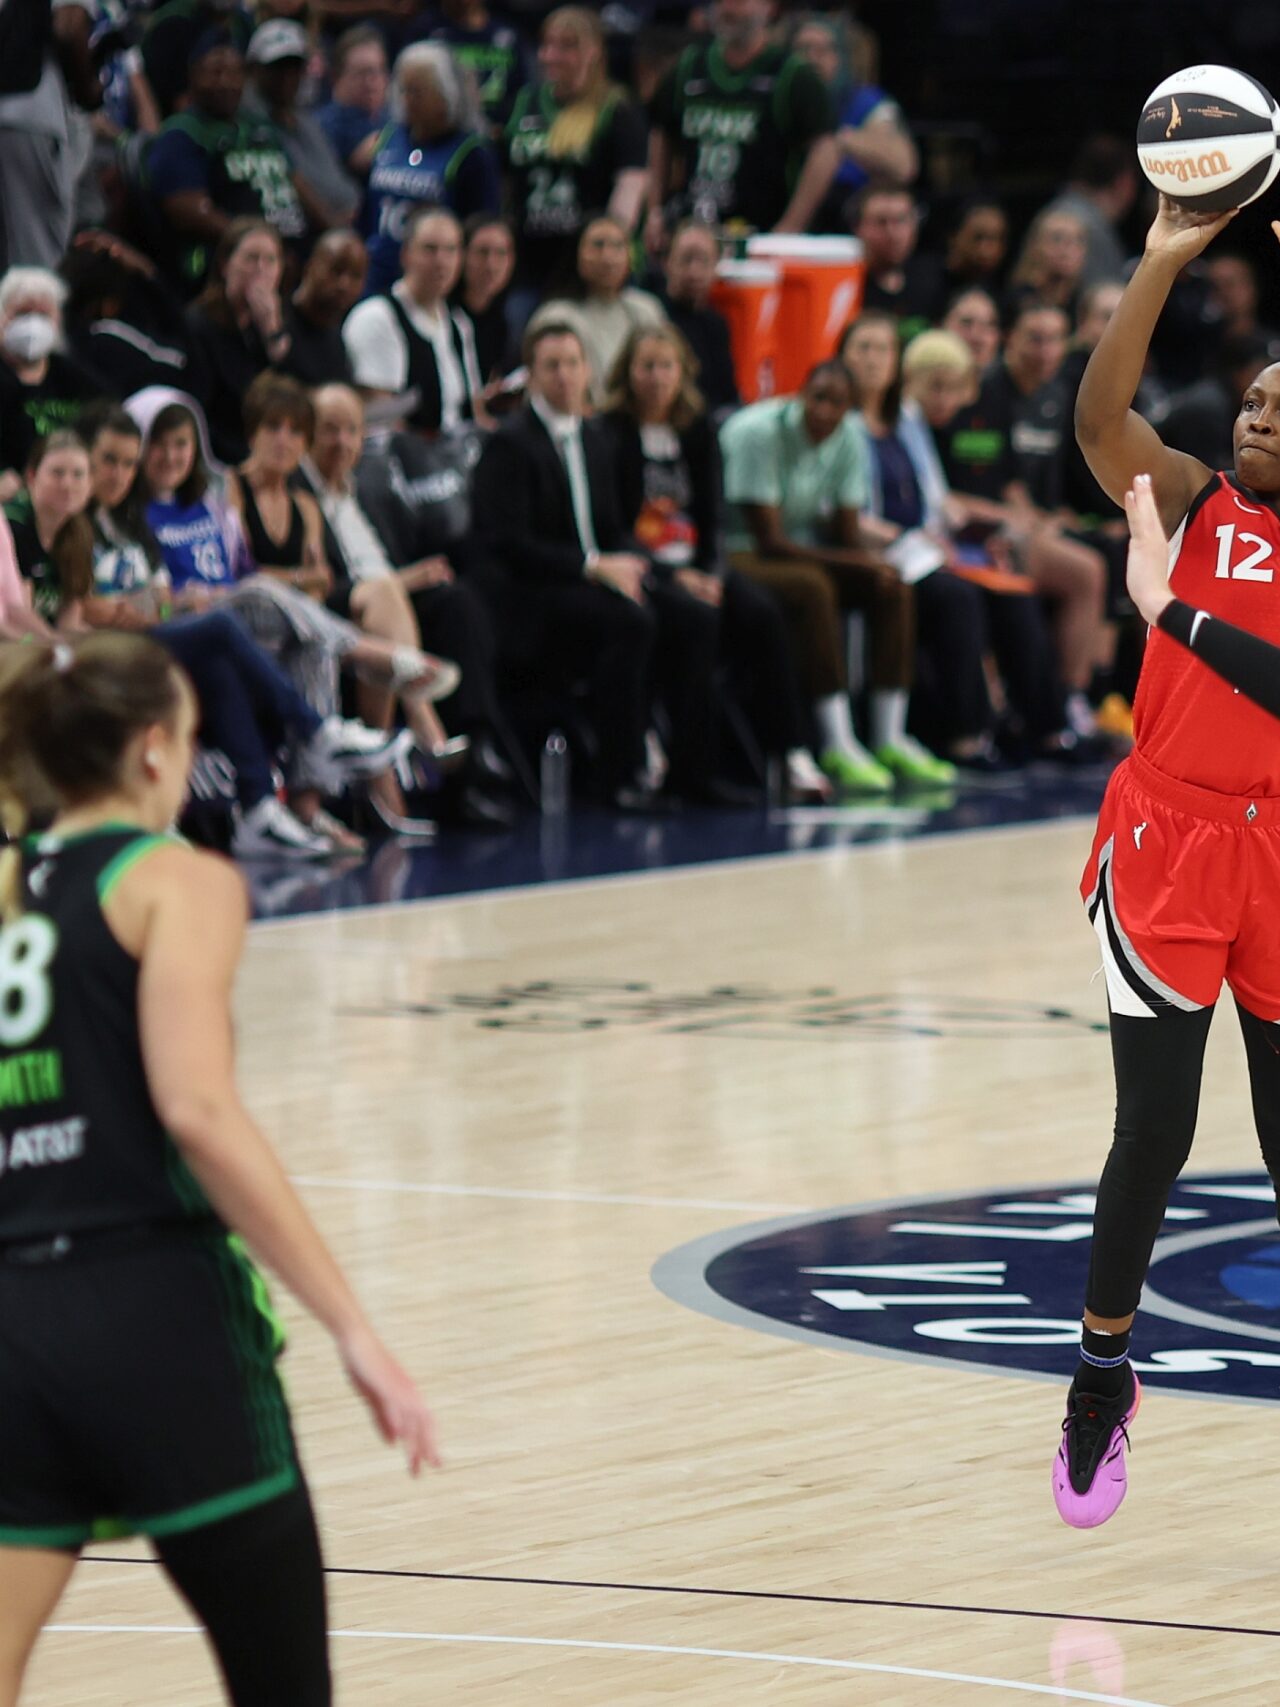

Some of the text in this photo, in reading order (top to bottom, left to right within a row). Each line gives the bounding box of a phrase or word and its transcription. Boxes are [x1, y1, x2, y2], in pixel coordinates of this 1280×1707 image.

[1143, 150, 1232, 183] Wilson
[1214, 523, 1274, 583] 12
[0, 911, 59, 1047] 8
[0, 1049, 62, 1107] MITH
[9, 1115, 88, 1170] AT&T
